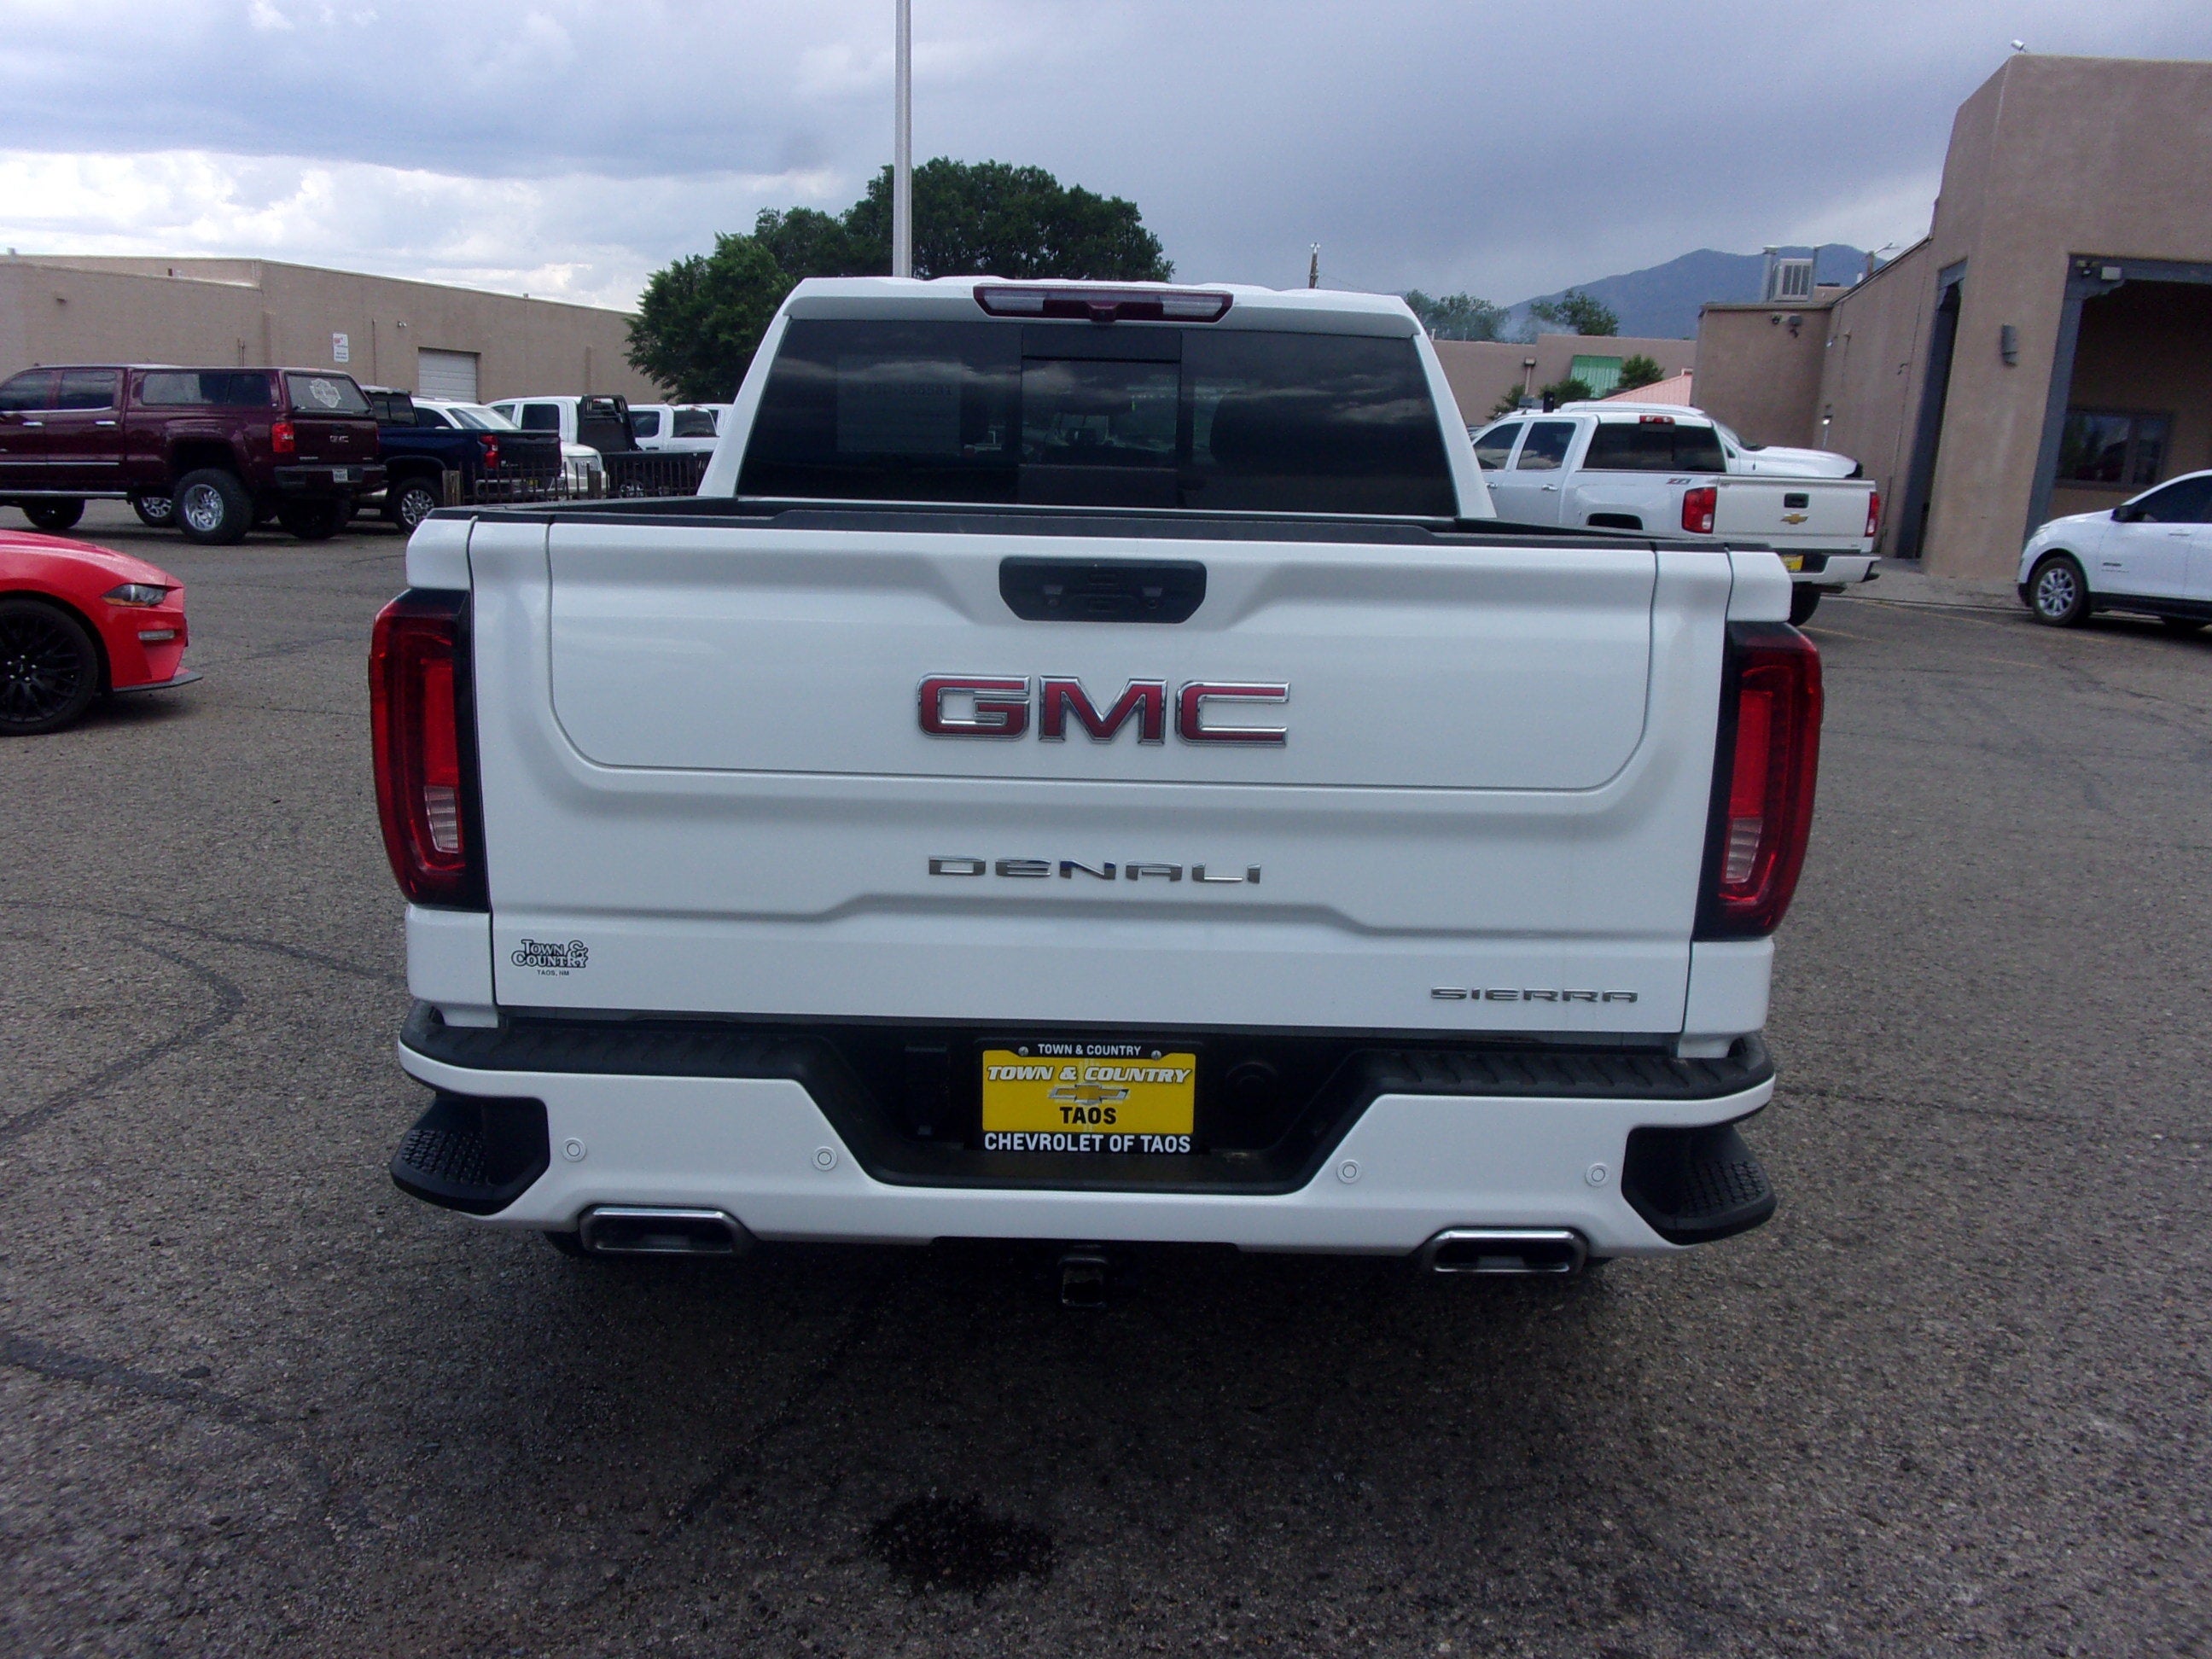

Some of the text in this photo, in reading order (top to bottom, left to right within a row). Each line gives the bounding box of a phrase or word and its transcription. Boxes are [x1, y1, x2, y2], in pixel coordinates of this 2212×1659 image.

[917, 673, 1289, 747] GMC
[928, 855, 1261, 884] DENALI
[1431, 987, 1639, 1003] SIERRA
[1038, 1043, 1142, 1057] TOWN & COUNTRY
[987, 1065, 1191, 1084] TOWN & COUNTRY
[1060, 1106, 1117, 1125] TAOS
[984, 1132, 1190, 1153] CHEVROLET OF TAOS
